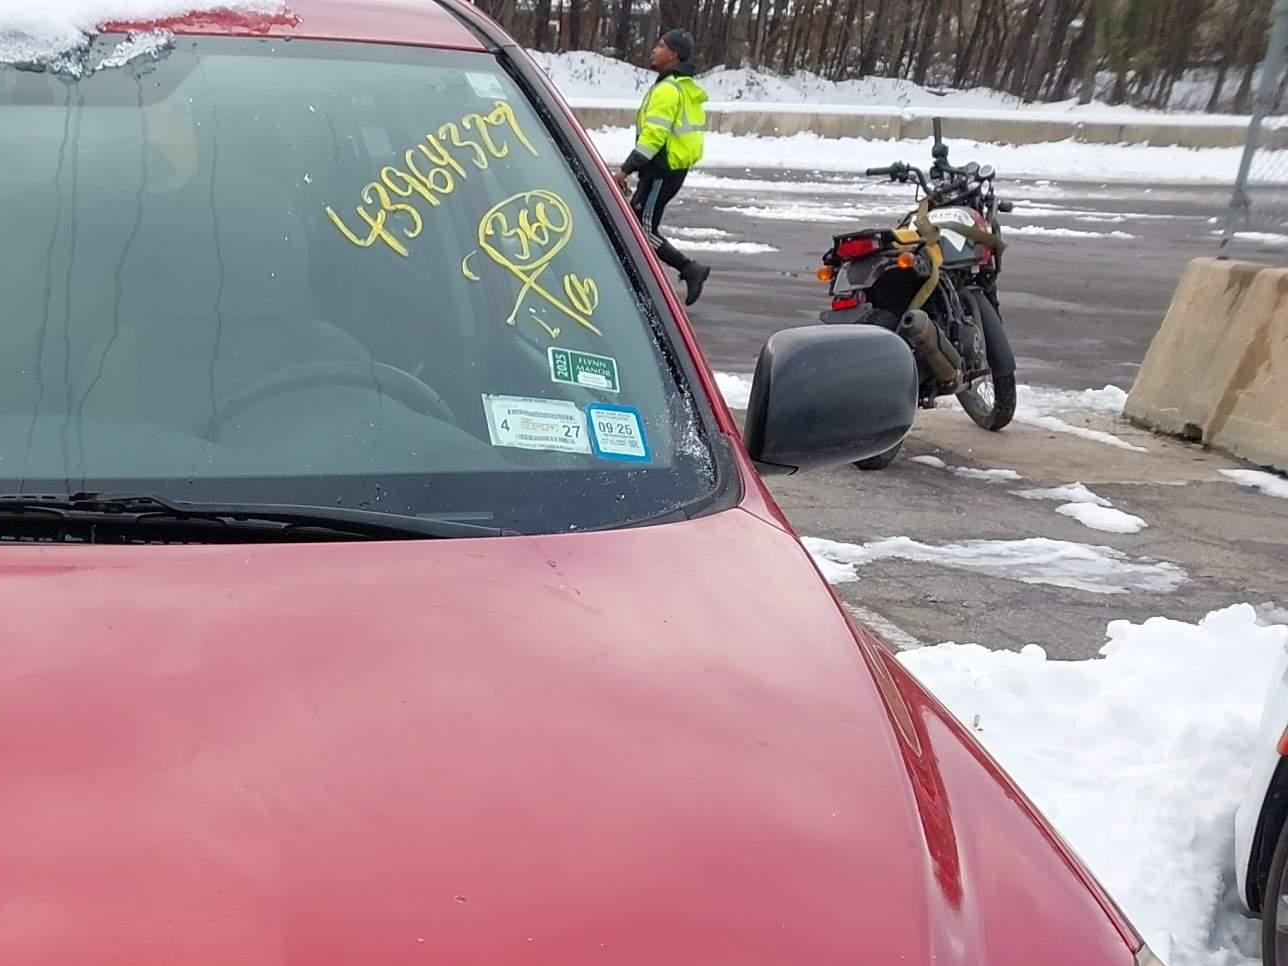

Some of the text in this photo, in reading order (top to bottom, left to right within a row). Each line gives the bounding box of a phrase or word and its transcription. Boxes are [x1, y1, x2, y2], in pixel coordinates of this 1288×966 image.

[485, 200, 569, 260] 360
[555, 353, 569, 378] 2025
[576, 364, 611, 377] MANOR
[578, 357, 607, 369] FLYNN
[500, 418, 511, 432] 4
[562, 424, 581, 439] 27
[598, 421, 633, 436] 09 25
